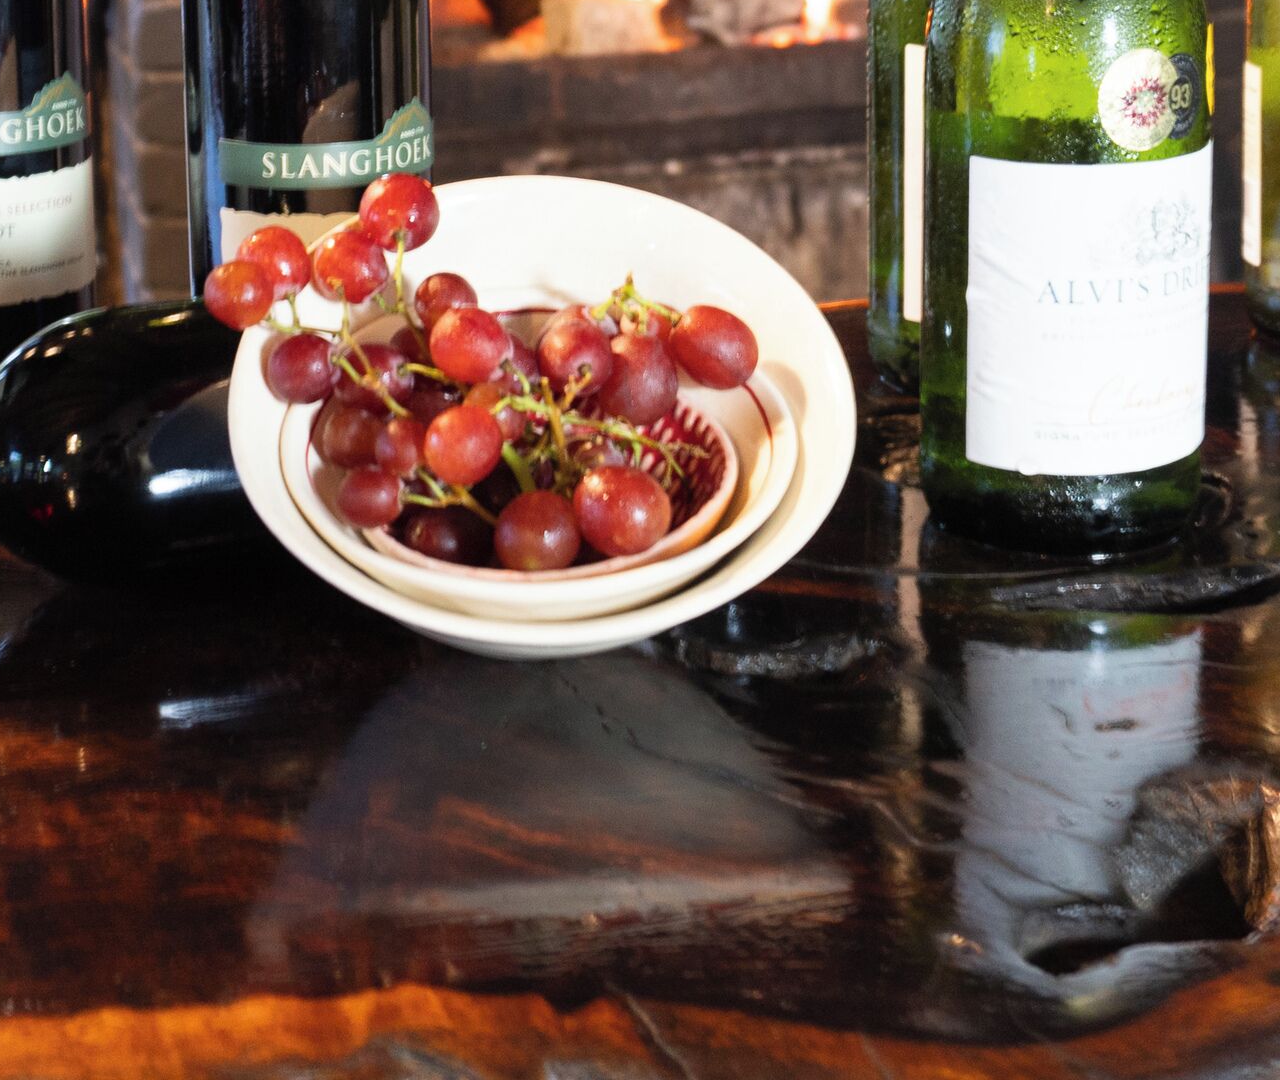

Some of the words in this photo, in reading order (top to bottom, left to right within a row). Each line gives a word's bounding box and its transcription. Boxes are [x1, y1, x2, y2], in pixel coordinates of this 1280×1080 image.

[1170, 83, 1191, 110] 93
[261, 133, 432, 179] SLANGHOEK
[1036, 275, 1150, 305] ALVI'S
